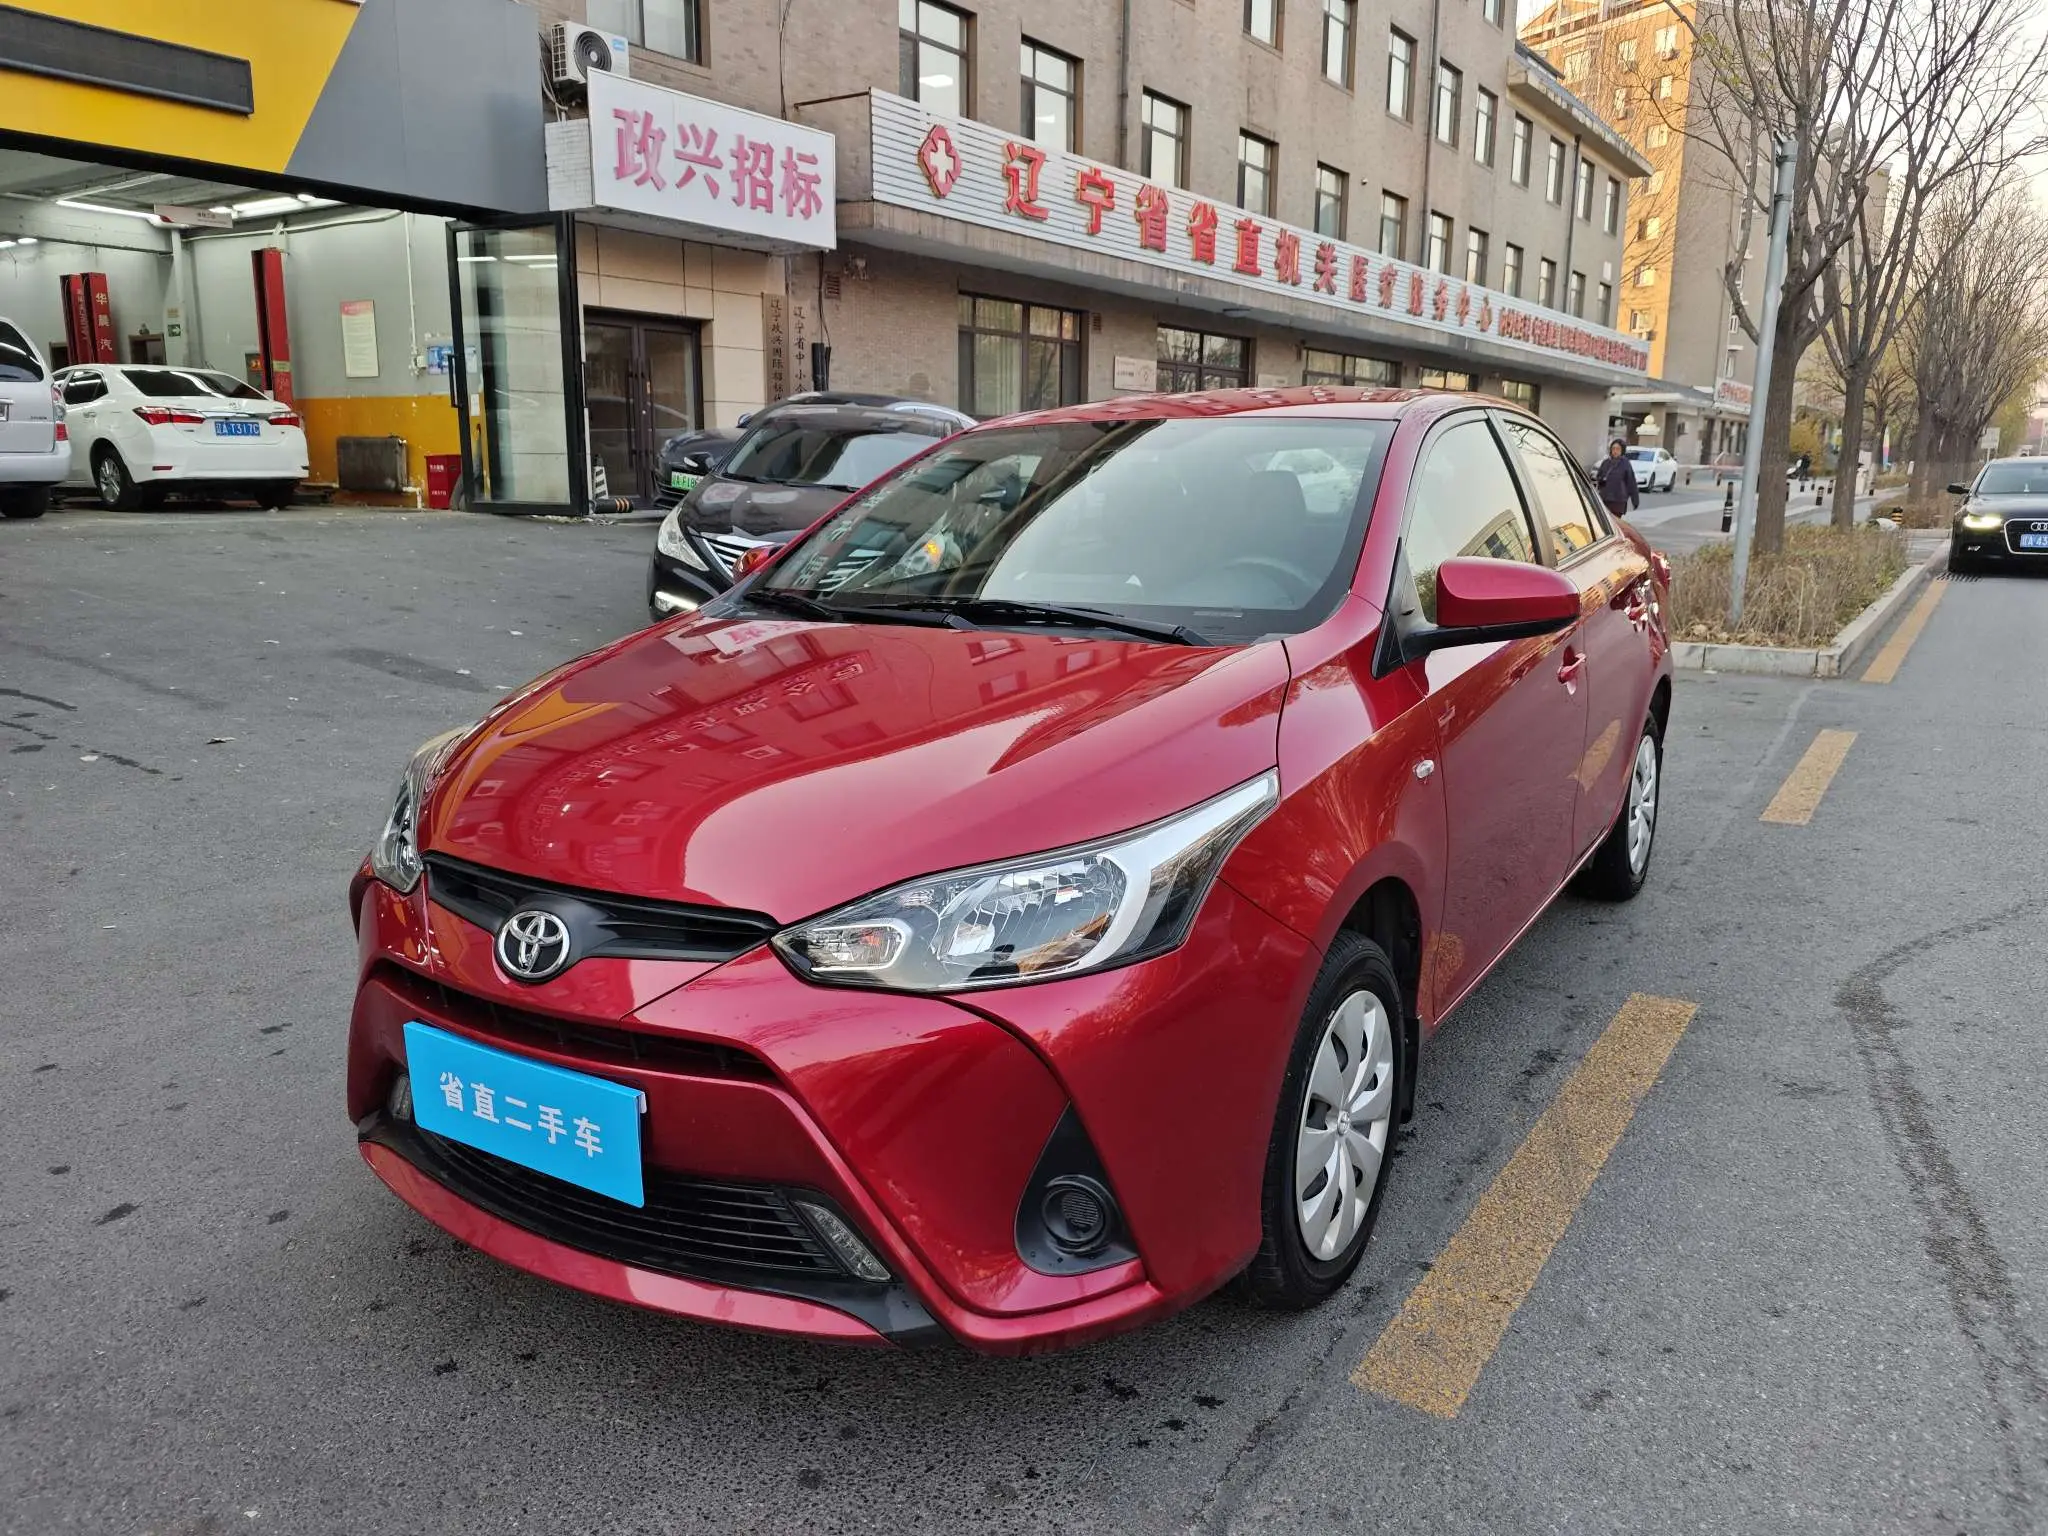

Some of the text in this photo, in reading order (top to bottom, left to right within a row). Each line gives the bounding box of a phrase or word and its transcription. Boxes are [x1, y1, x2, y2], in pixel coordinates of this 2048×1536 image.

[612, 108, 824, 220] 政兴招标
[440, 1071, 603, 1158] 省直二手车
